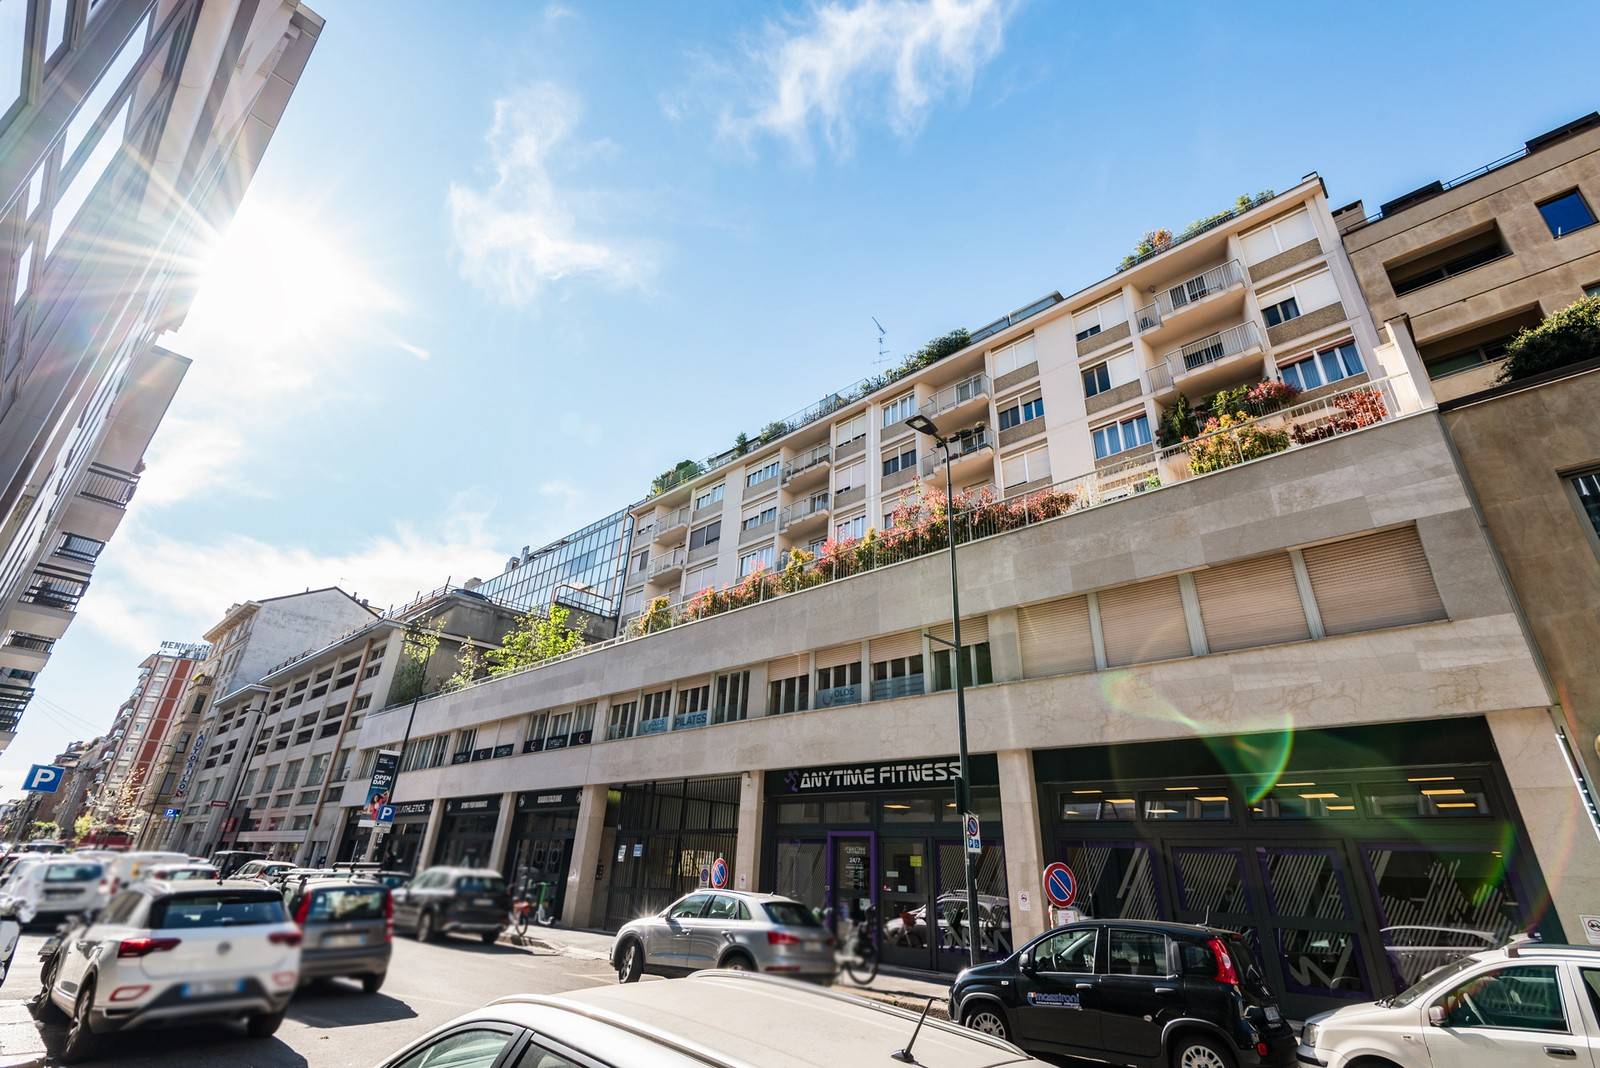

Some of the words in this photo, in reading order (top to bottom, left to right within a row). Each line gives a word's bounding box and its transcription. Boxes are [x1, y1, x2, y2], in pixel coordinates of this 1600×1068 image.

[675, 712, 708, 727] PILATES
[179, 734, 204, 790] AUTOSILO
[31, 768, 56, 788] P
[800, 767, 875, 788] ANYTIME
[879, 761, 963, 784] FITNESS
[380, 807, 393, 820] P
[400, 803, 426, 814] ATHLETICS
